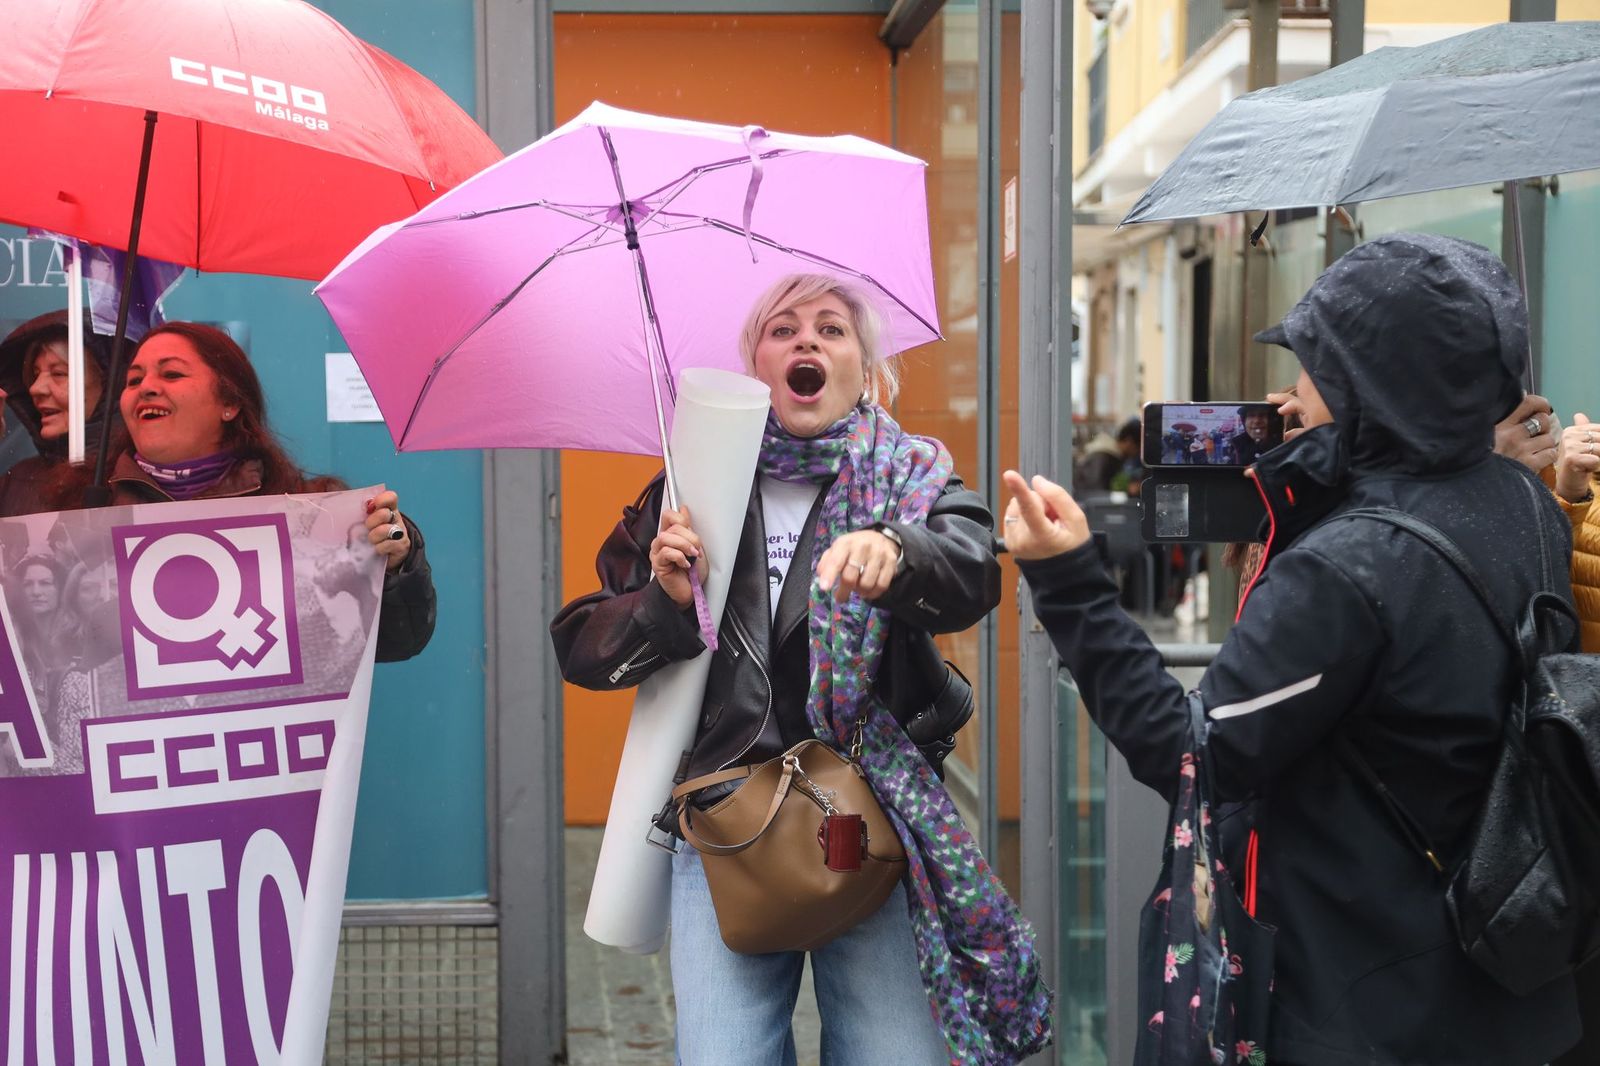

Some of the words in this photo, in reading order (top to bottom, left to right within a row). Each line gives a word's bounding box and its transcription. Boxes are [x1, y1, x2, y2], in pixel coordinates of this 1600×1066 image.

[169, 56, 327, 114] CCOO
[255, 101, 329, 131] Málaga
[766, 535, 784, 544] er
[767, 547, 795, 559] sit
[106, 719, 336, 794] CCOO
